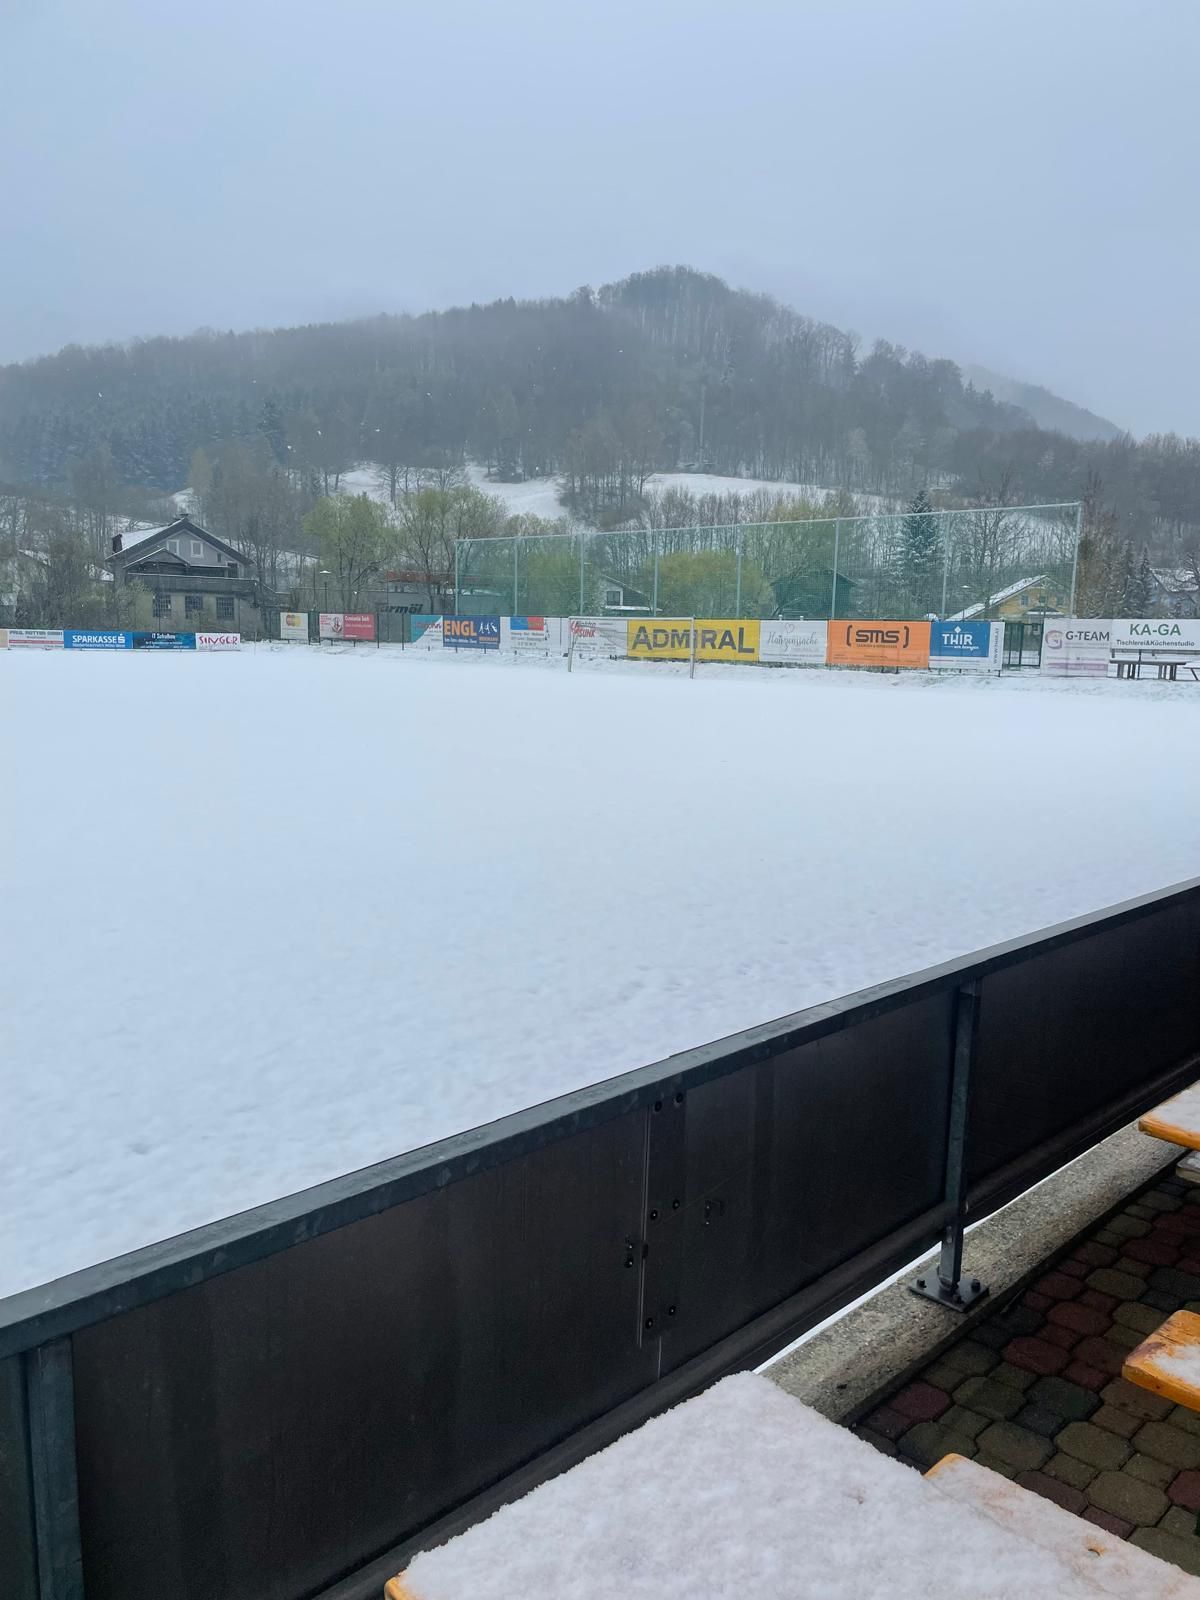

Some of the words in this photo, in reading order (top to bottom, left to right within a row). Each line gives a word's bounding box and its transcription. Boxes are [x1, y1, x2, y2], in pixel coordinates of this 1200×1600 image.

[444, 620, 477, 636] ENGL
[1129, 624, 1181, 636] KA-GA
[72, 635, 117, 643] SPARKASSE
[199, 635, 238, 645] SINGER
[632, 626, 755, 653] ADMIRAL
[942, 634, 973, 645] THIR
[1065, 631, 1110, 641] G-TEAM
[1116, 639, 1195, 647] Tischlerei&Küchenstudio
